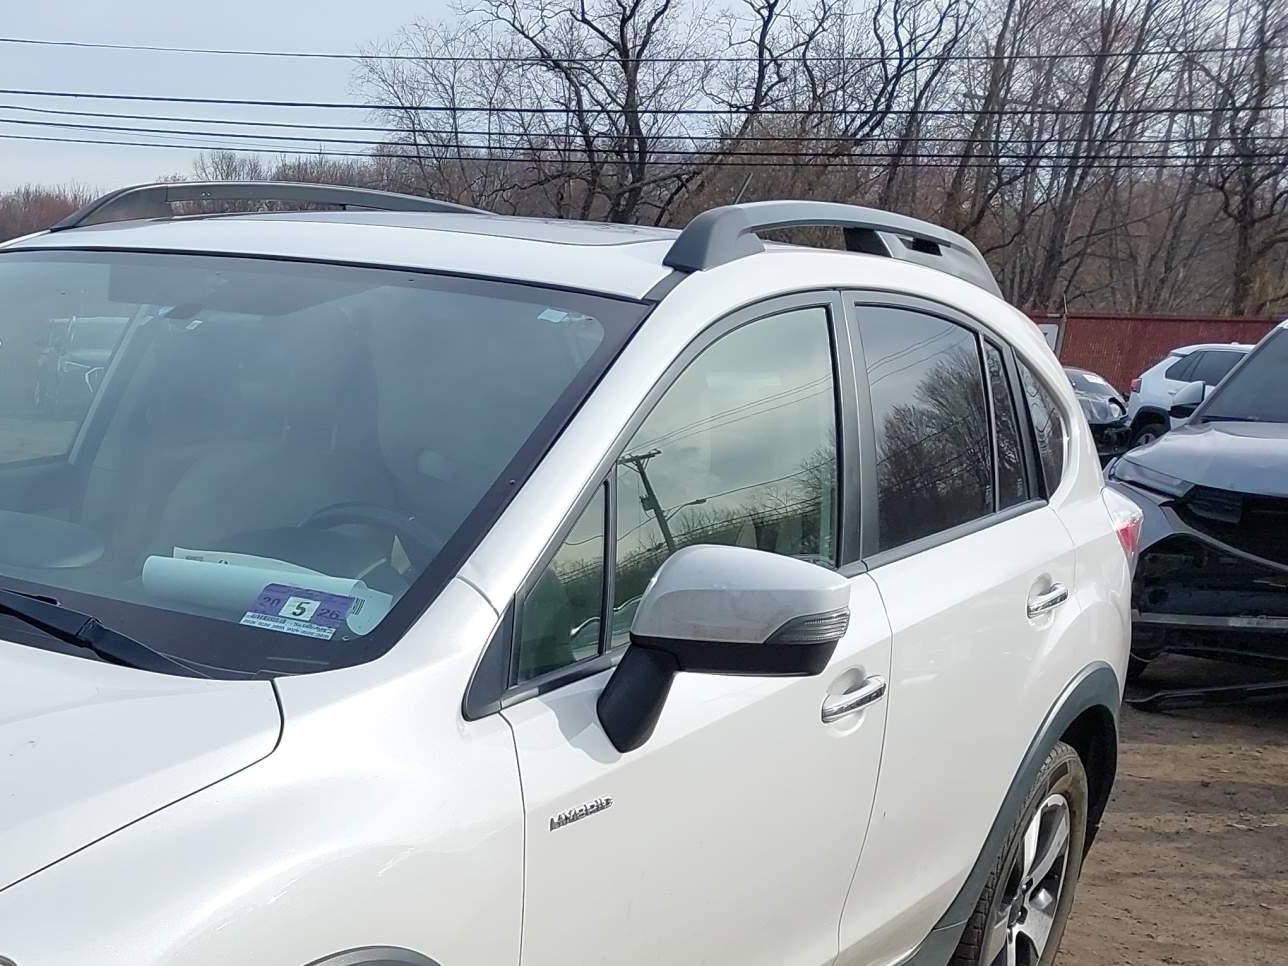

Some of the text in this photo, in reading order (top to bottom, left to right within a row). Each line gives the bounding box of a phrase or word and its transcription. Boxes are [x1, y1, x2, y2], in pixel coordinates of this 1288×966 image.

[263, 596, 342, 620] 20 5 26
